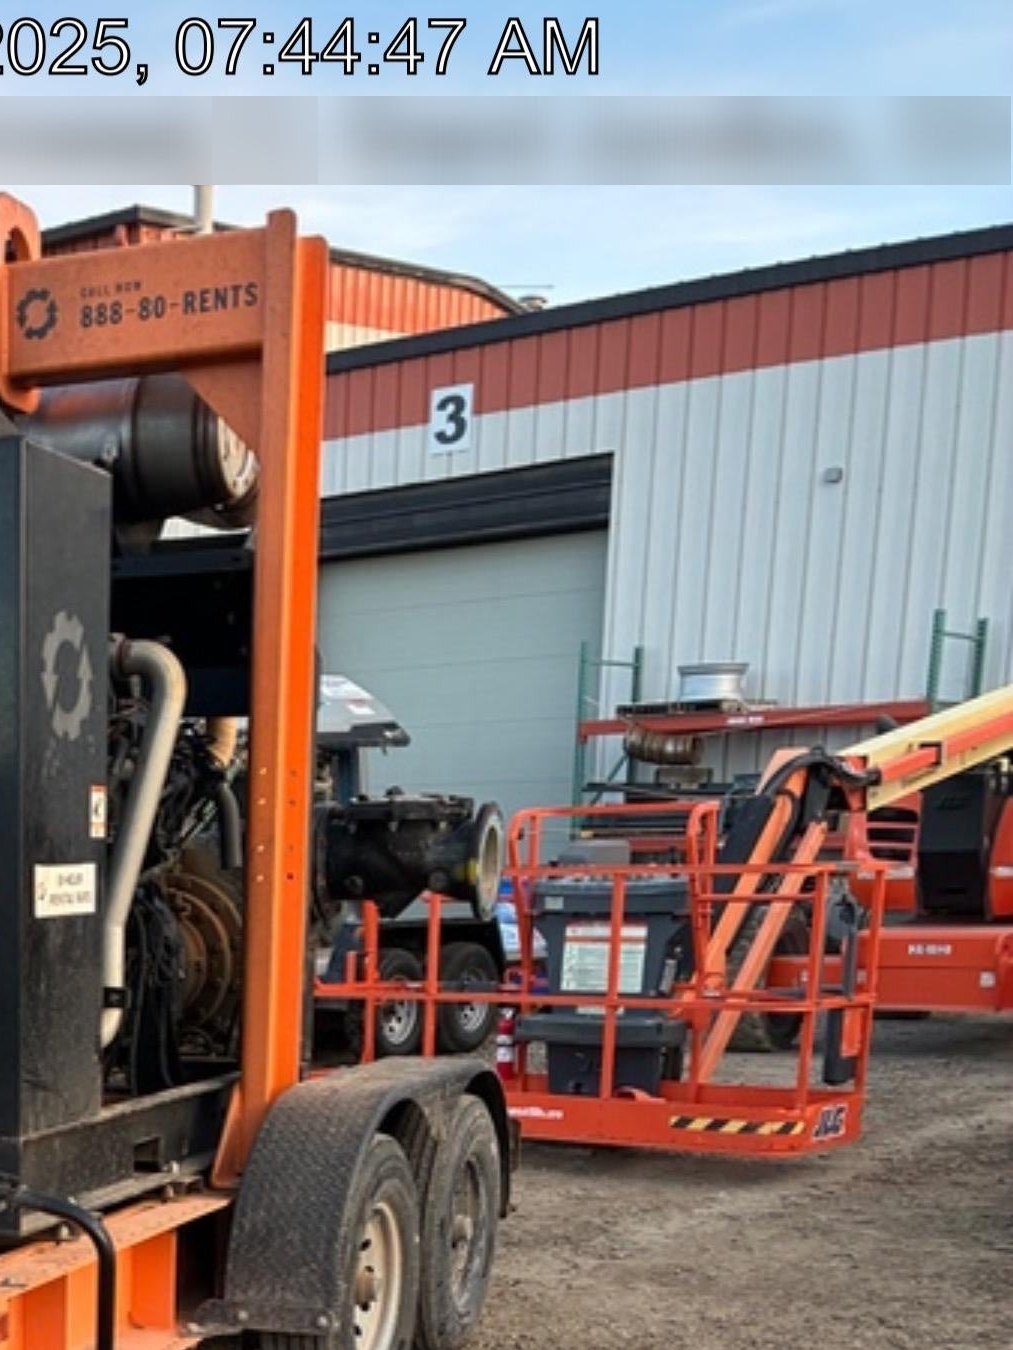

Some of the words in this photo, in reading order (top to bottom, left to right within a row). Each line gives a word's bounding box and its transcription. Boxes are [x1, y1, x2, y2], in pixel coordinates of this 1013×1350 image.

[80, 285, 111, 300] CALL
[80, 281, 260, 329] 888-80-RENTS
[434, 395, 467, 445] 3
